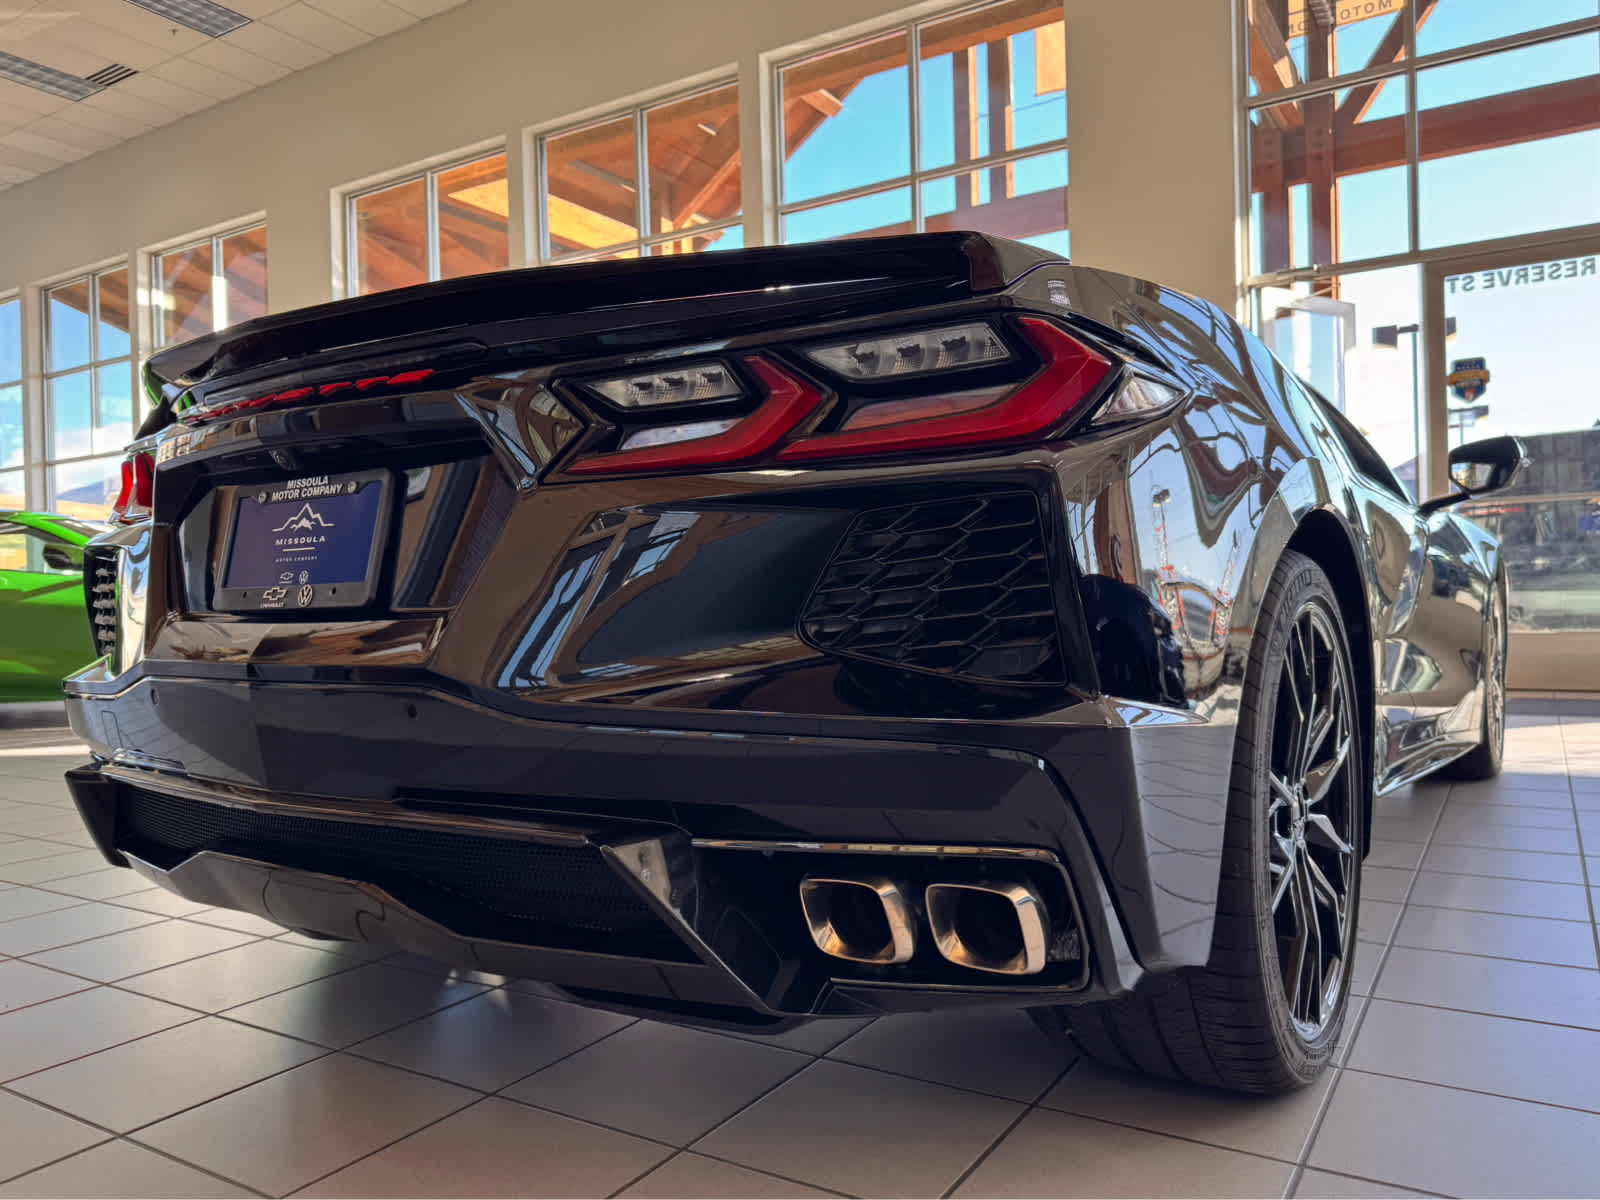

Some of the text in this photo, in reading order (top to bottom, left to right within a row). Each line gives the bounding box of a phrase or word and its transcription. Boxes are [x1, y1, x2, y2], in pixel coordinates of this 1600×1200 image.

[287, 476, 329, 489] MISSOULA
[271, 484, 343, 502] MOTOR COMPANY
[275, 535, 326, 546] MISSOULA
